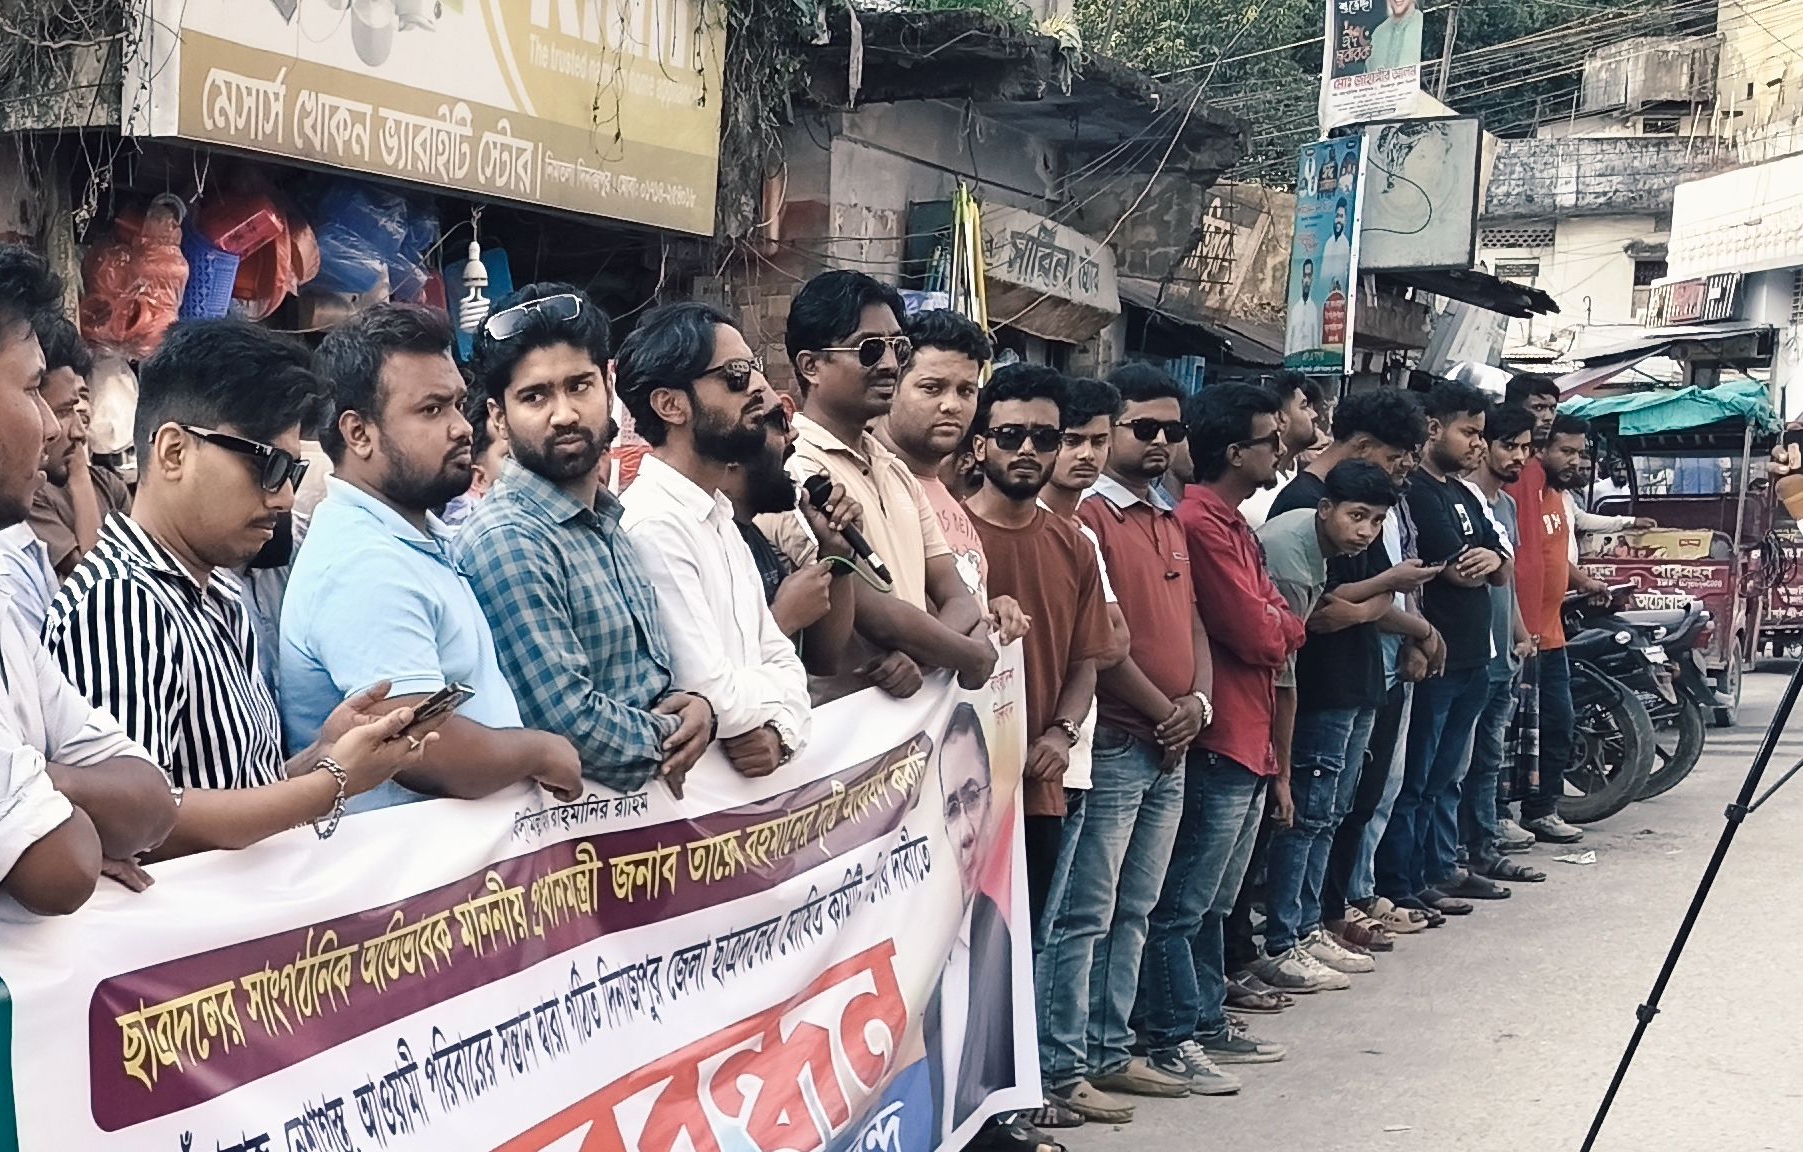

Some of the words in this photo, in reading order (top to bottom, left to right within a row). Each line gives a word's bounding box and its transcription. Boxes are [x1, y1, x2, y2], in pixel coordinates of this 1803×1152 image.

[201, 66, 287, 144] মেসার্স
[293, 89, 373, 162] খোকন
[378, 101, 474, 183] ভ্যারাইটি
[115, 980, 247, 1092] ছাত্রদলের
[240, 926, 359, 1036] সাংগঠনিক
[360, 910, 455, 993] অভিভাবক
[452, 869, 529, 960] মাননীয়
[531, 841, 603, 938] প্রধানমন্ত্রী
[609, 841, 682, 904] জনাব
[352, 1038, 431, 1151] আওয়ামী
[425, 1025, 499, 1121] পরিবারের
[597, 954, 663, 1031] দিনাজপুর
[667, 934, 713, 1002] জেলা
[711, 912, 782, 987] ছাত্রদলের
[890, 825, 932, 896] দাবীতে
